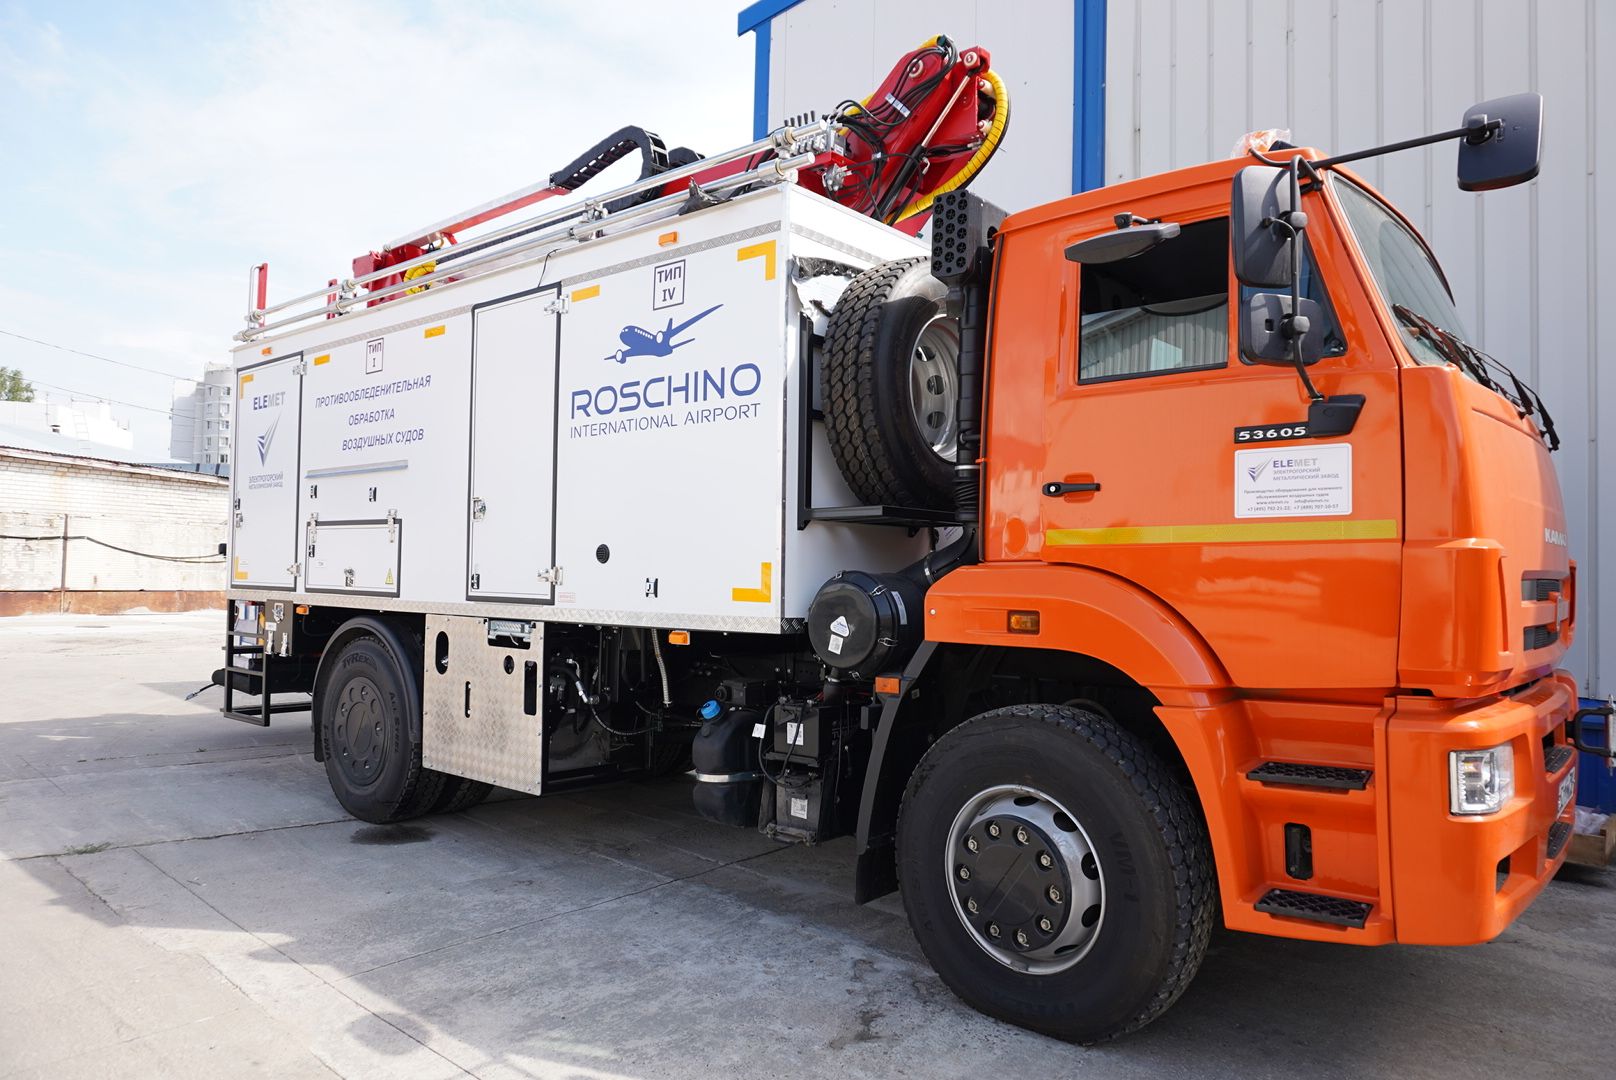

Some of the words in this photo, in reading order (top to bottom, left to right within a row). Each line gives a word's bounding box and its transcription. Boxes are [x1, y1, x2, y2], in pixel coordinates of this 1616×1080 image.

[657, 266, 682, 284] ТИП
[662, 287, 676, 302] IV
[368, 341, 382, 353] ТИП
[253, 391, 286, 410] ELEMET
[315, 375, 432, 408] ПРОТИВООБЛЕДЕНИТЕЛЬНАЯ
[571, 363, 762, 420] ROSCHINO
[348, 408, 395, 426] ОБРАБОТКА
[570, 413, 678, 439] INTERNATIONAL
[684, 402, 761, 425] AIRPORT
[342, 433, 394, 451] ВОЗДУШНЫХ
[395, 428, 424, 443] СУДОВ
[1238, 426, 1306, 441] 53605
[1273, 458, 1318, 468] ELEMET
[1273, 466, 1321, 475] ЭЛЕКТРОГОРСКИЙ
